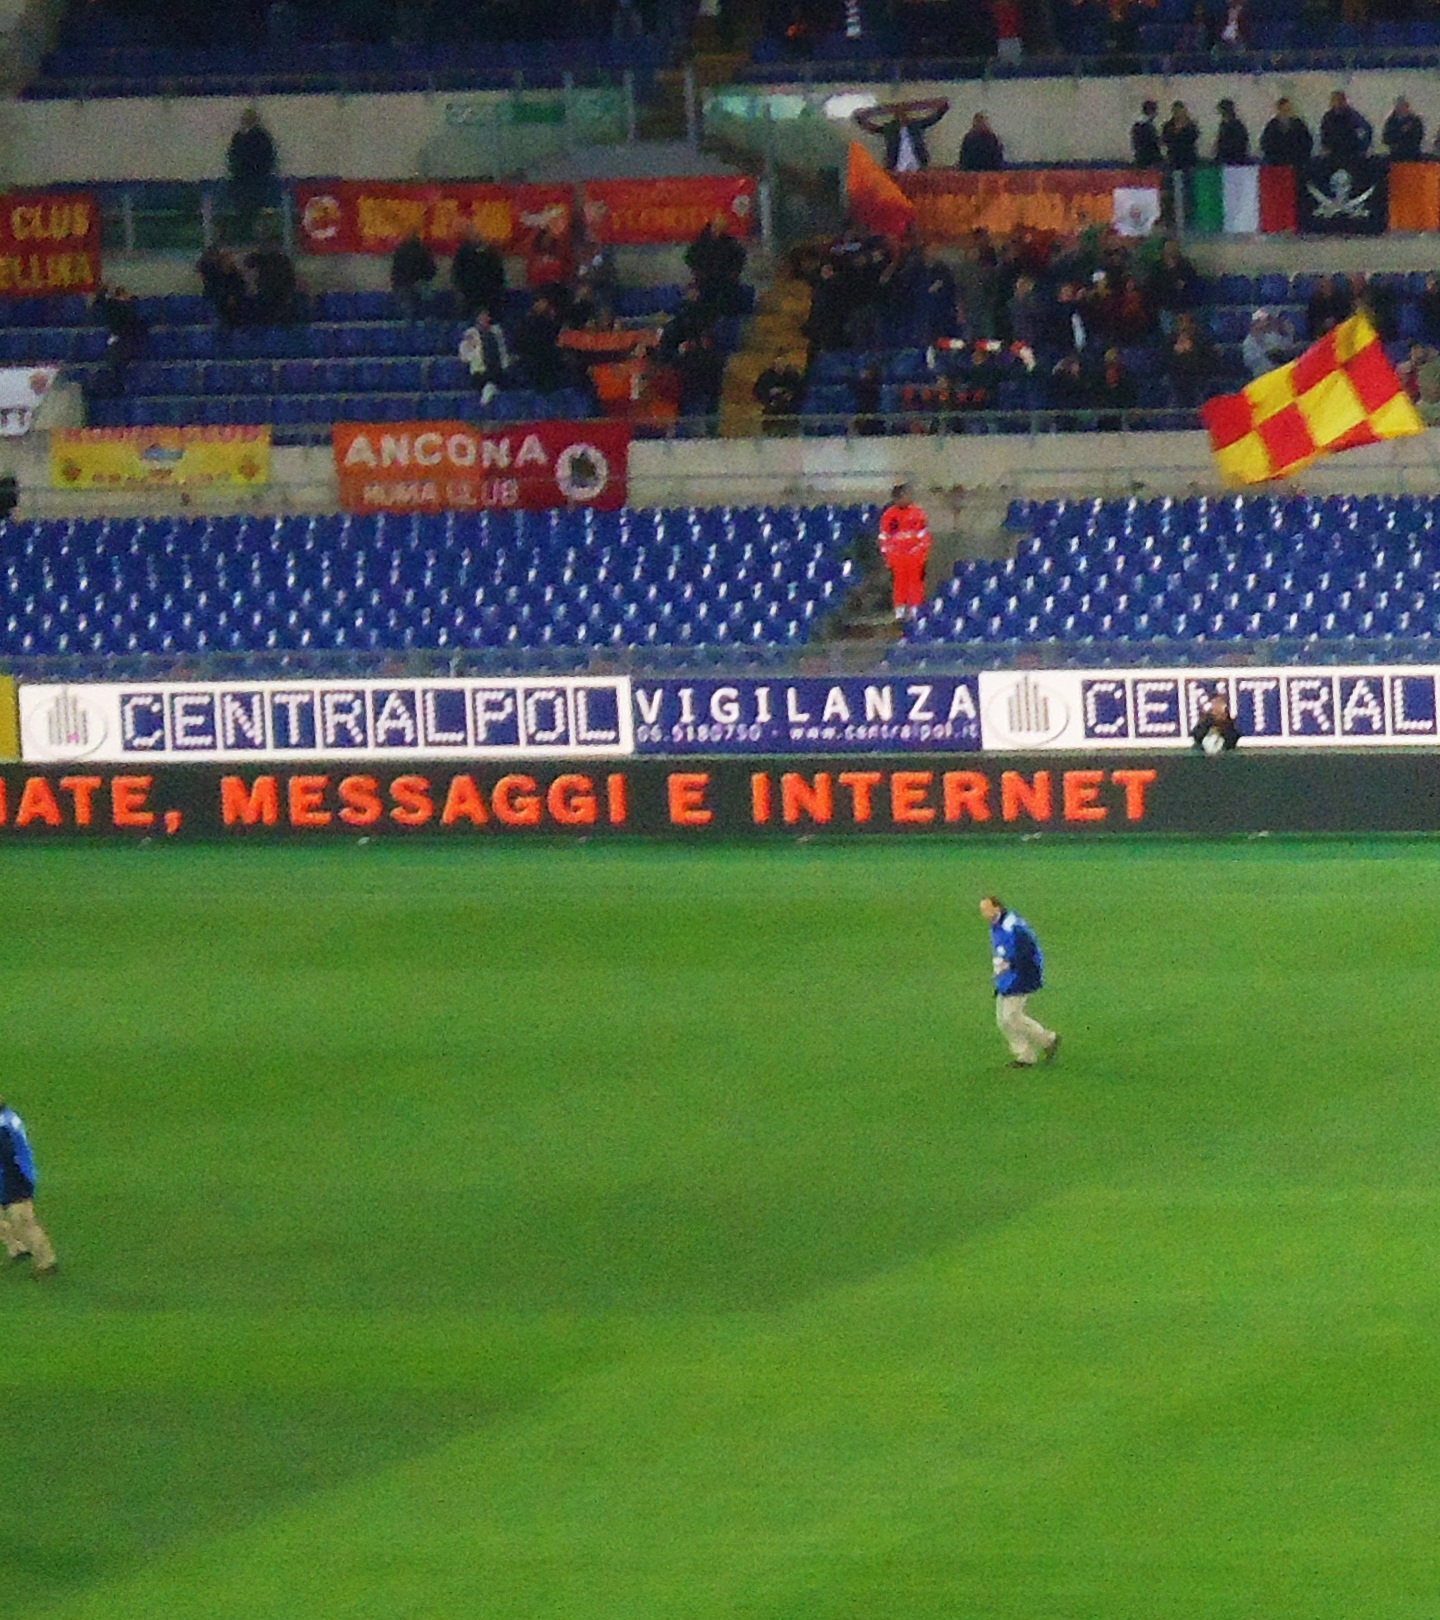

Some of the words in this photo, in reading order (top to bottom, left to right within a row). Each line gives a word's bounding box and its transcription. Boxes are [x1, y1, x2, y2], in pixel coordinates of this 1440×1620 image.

[343, 432, 550, 469] ANCONA
[121, 688, 622, 751] CENTRALPOL
[635, 684, 977, 724] VIGILANZA
[0, 774, 182, 833] ATE,
[220, 774, 627, 826] MESSAGGI
[668, 773, 713, 824] E
[751, 769, 1159, 824] INTERNET
